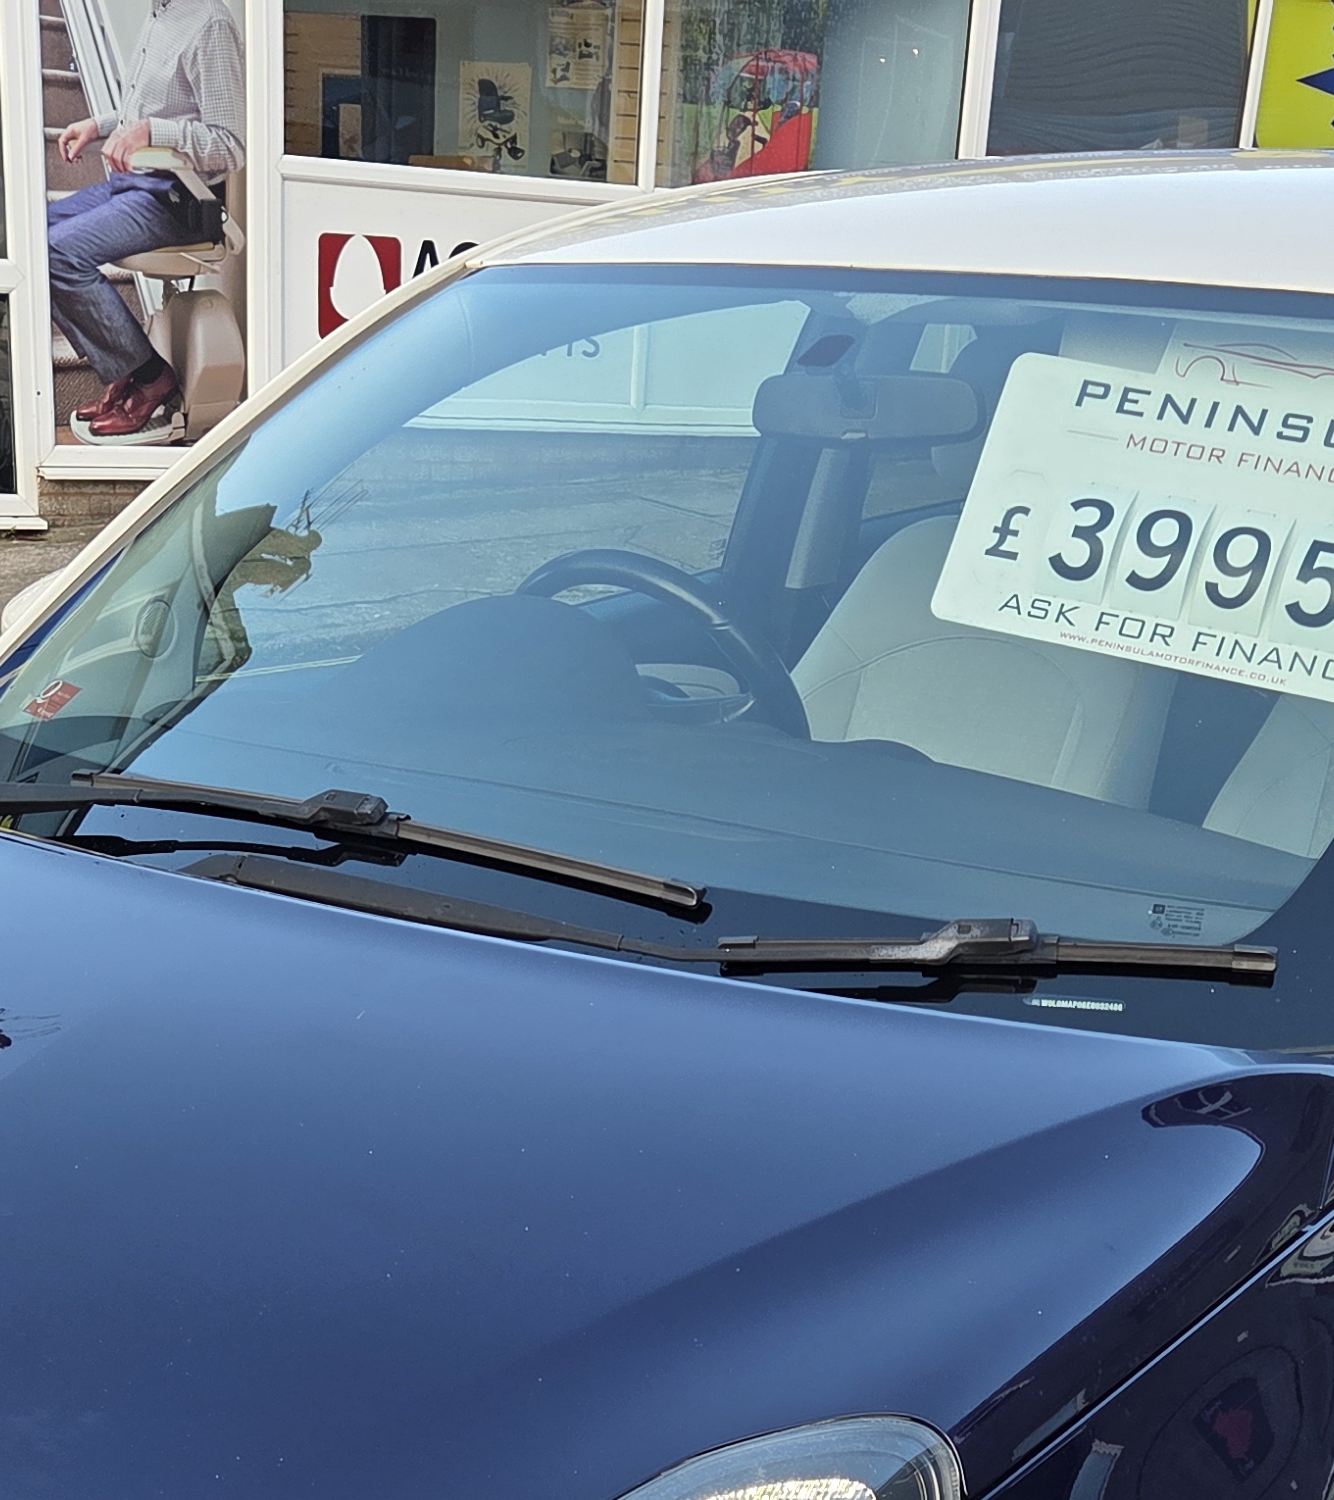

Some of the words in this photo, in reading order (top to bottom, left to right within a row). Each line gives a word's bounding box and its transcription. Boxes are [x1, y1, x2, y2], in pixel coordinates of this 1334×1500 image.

[1126, 434, 1226, 465] MOTOR
[998, 593, 1081, 627] ASK
[1095, 612, 1175, 647] FOR
[1060, 631, 1288, 686] WWW.PENINSULAMOTORFINANCE.CO.UK
